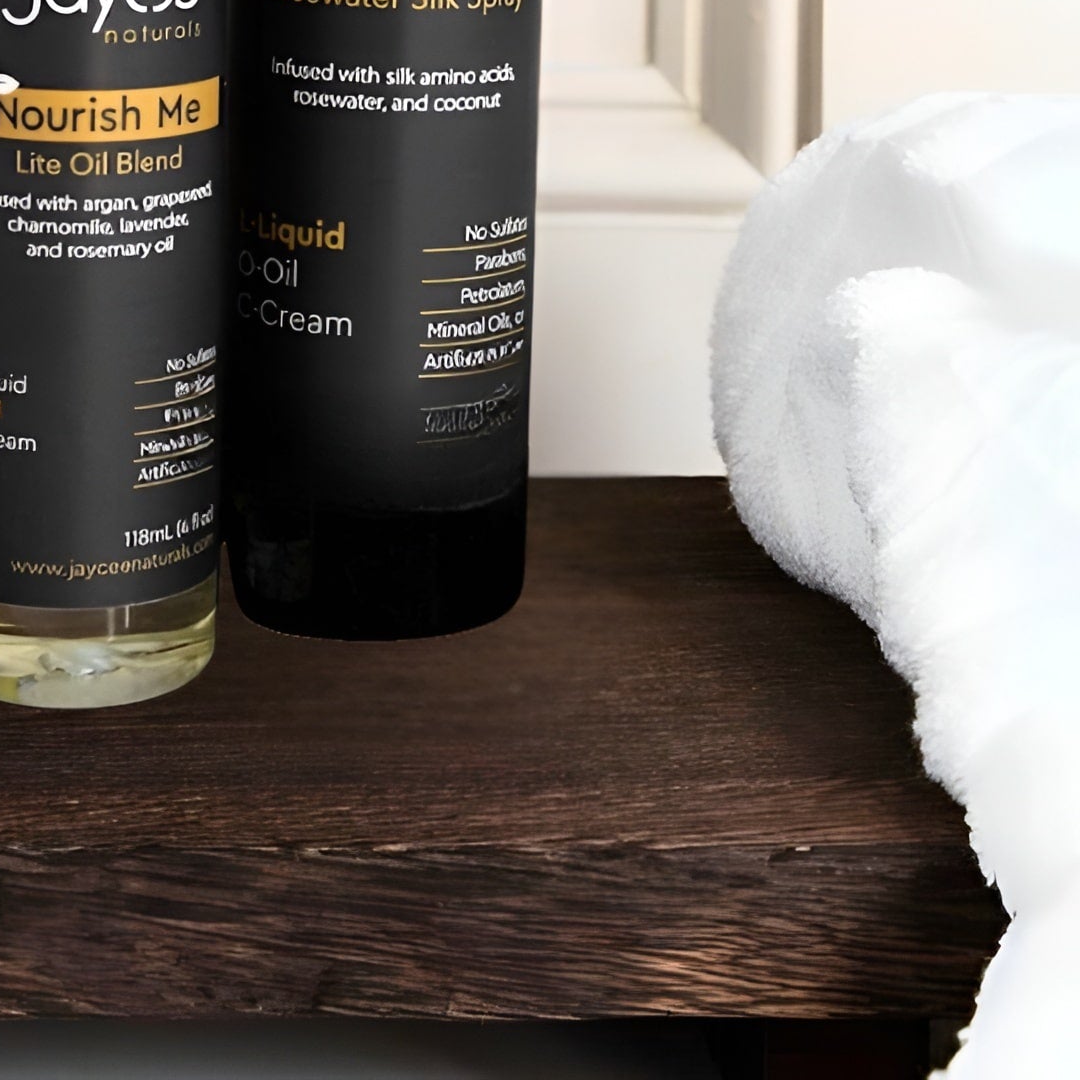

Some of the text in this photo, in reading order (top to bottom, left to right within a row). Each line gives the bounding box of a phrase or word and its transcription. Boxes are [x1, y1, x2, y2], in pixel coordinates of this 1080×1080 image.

[104, 20, 201, 44] naturals
[271, 56, 334, 82] Infused
[338, 66, 380, 84] with
[386, 67, 416, 86] silk
[420, 68, 476, 86] amino
[158, 94, 201, 127] Me
[391, 93, 428, 113] and
[433, 92, 501, 113] coconut
[16, 144, 183, 176] Lite Oil Blend
[36, 194, 78, 211] with
[465, 224, 487, 242] No
[26, 235, 174, 259] and rosemary oil
[238, 249, 298, 288] O-Oil
[237, 292, 353, 337] C-Cream
[427, 316, 485, 339] Mineral
[124, 524, 173, 547] 118mL
